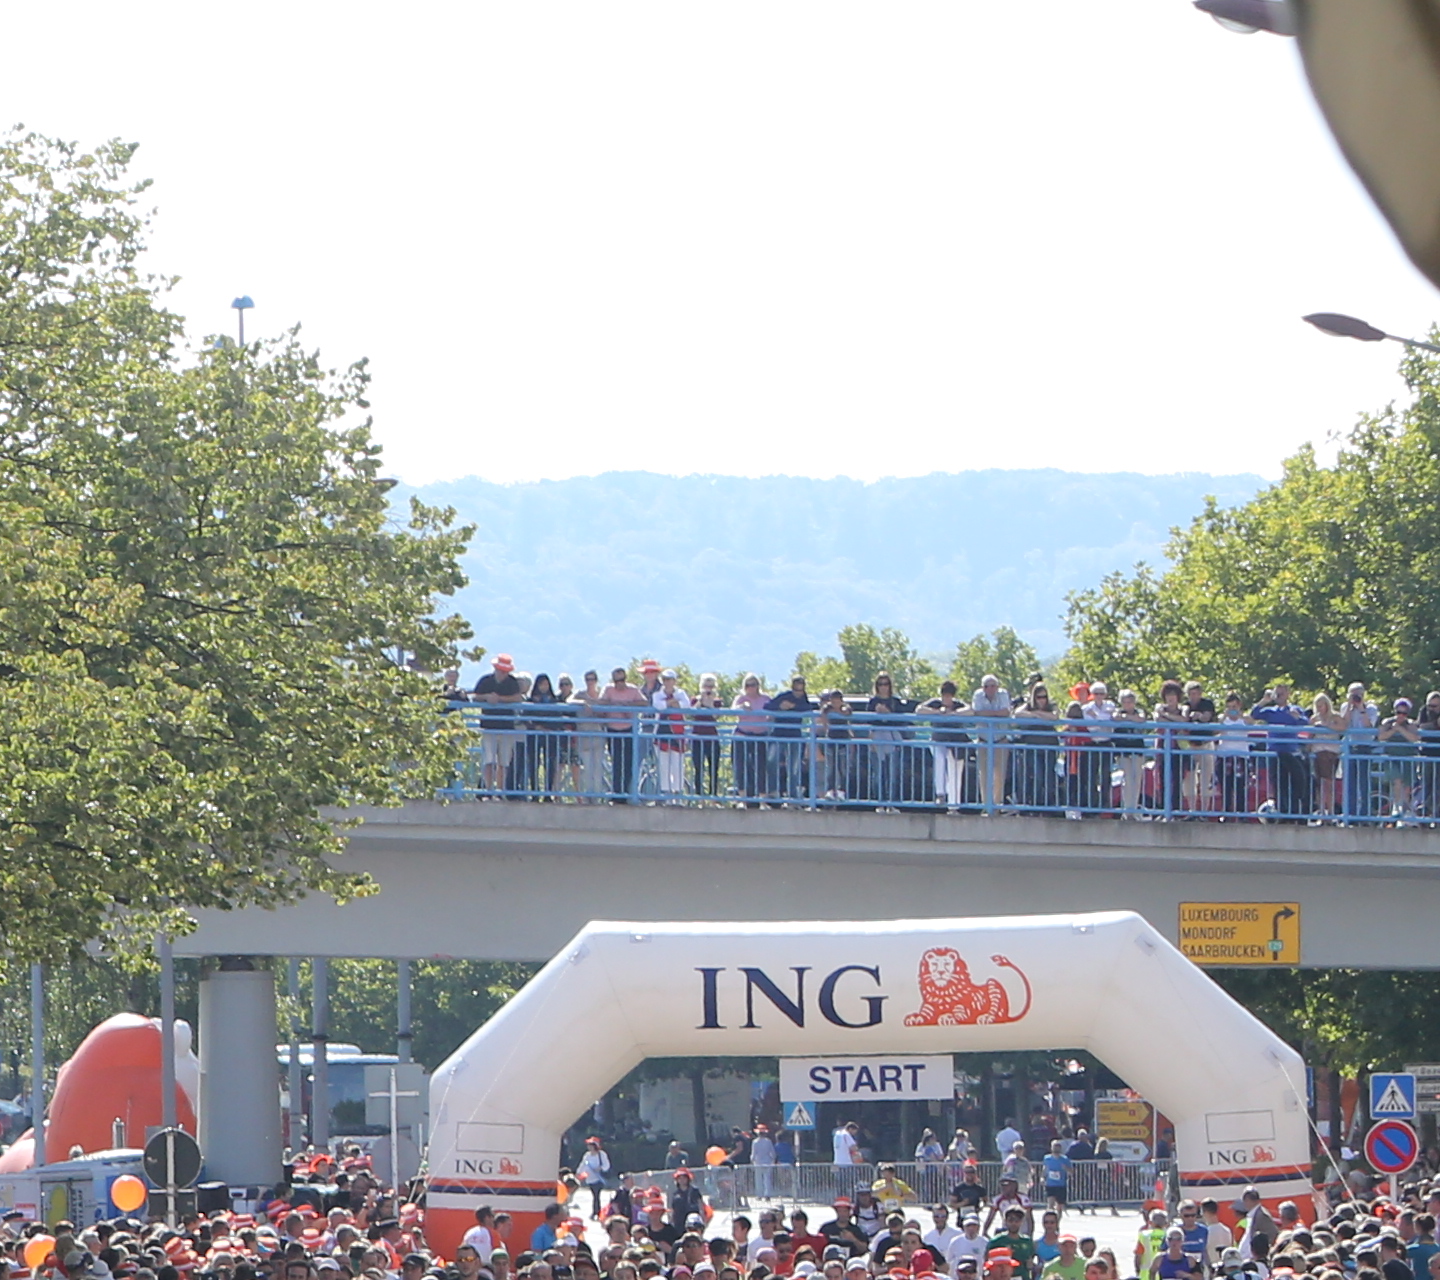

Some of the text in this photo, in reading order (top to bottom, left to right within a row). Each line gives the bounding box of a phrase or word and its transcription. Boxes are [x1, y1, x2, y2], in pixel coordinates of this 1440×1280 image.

[1182, 909, 1259, 922] LUXEMBOURG
[1182, 927, 1237, 940] MONDORF
[695, 966, 888, 1029] ING
[809, 1064, 926, 1094] START
[1208, 1150, 1247, 1166] ING
[455, 1160, 494, 1175] ING
